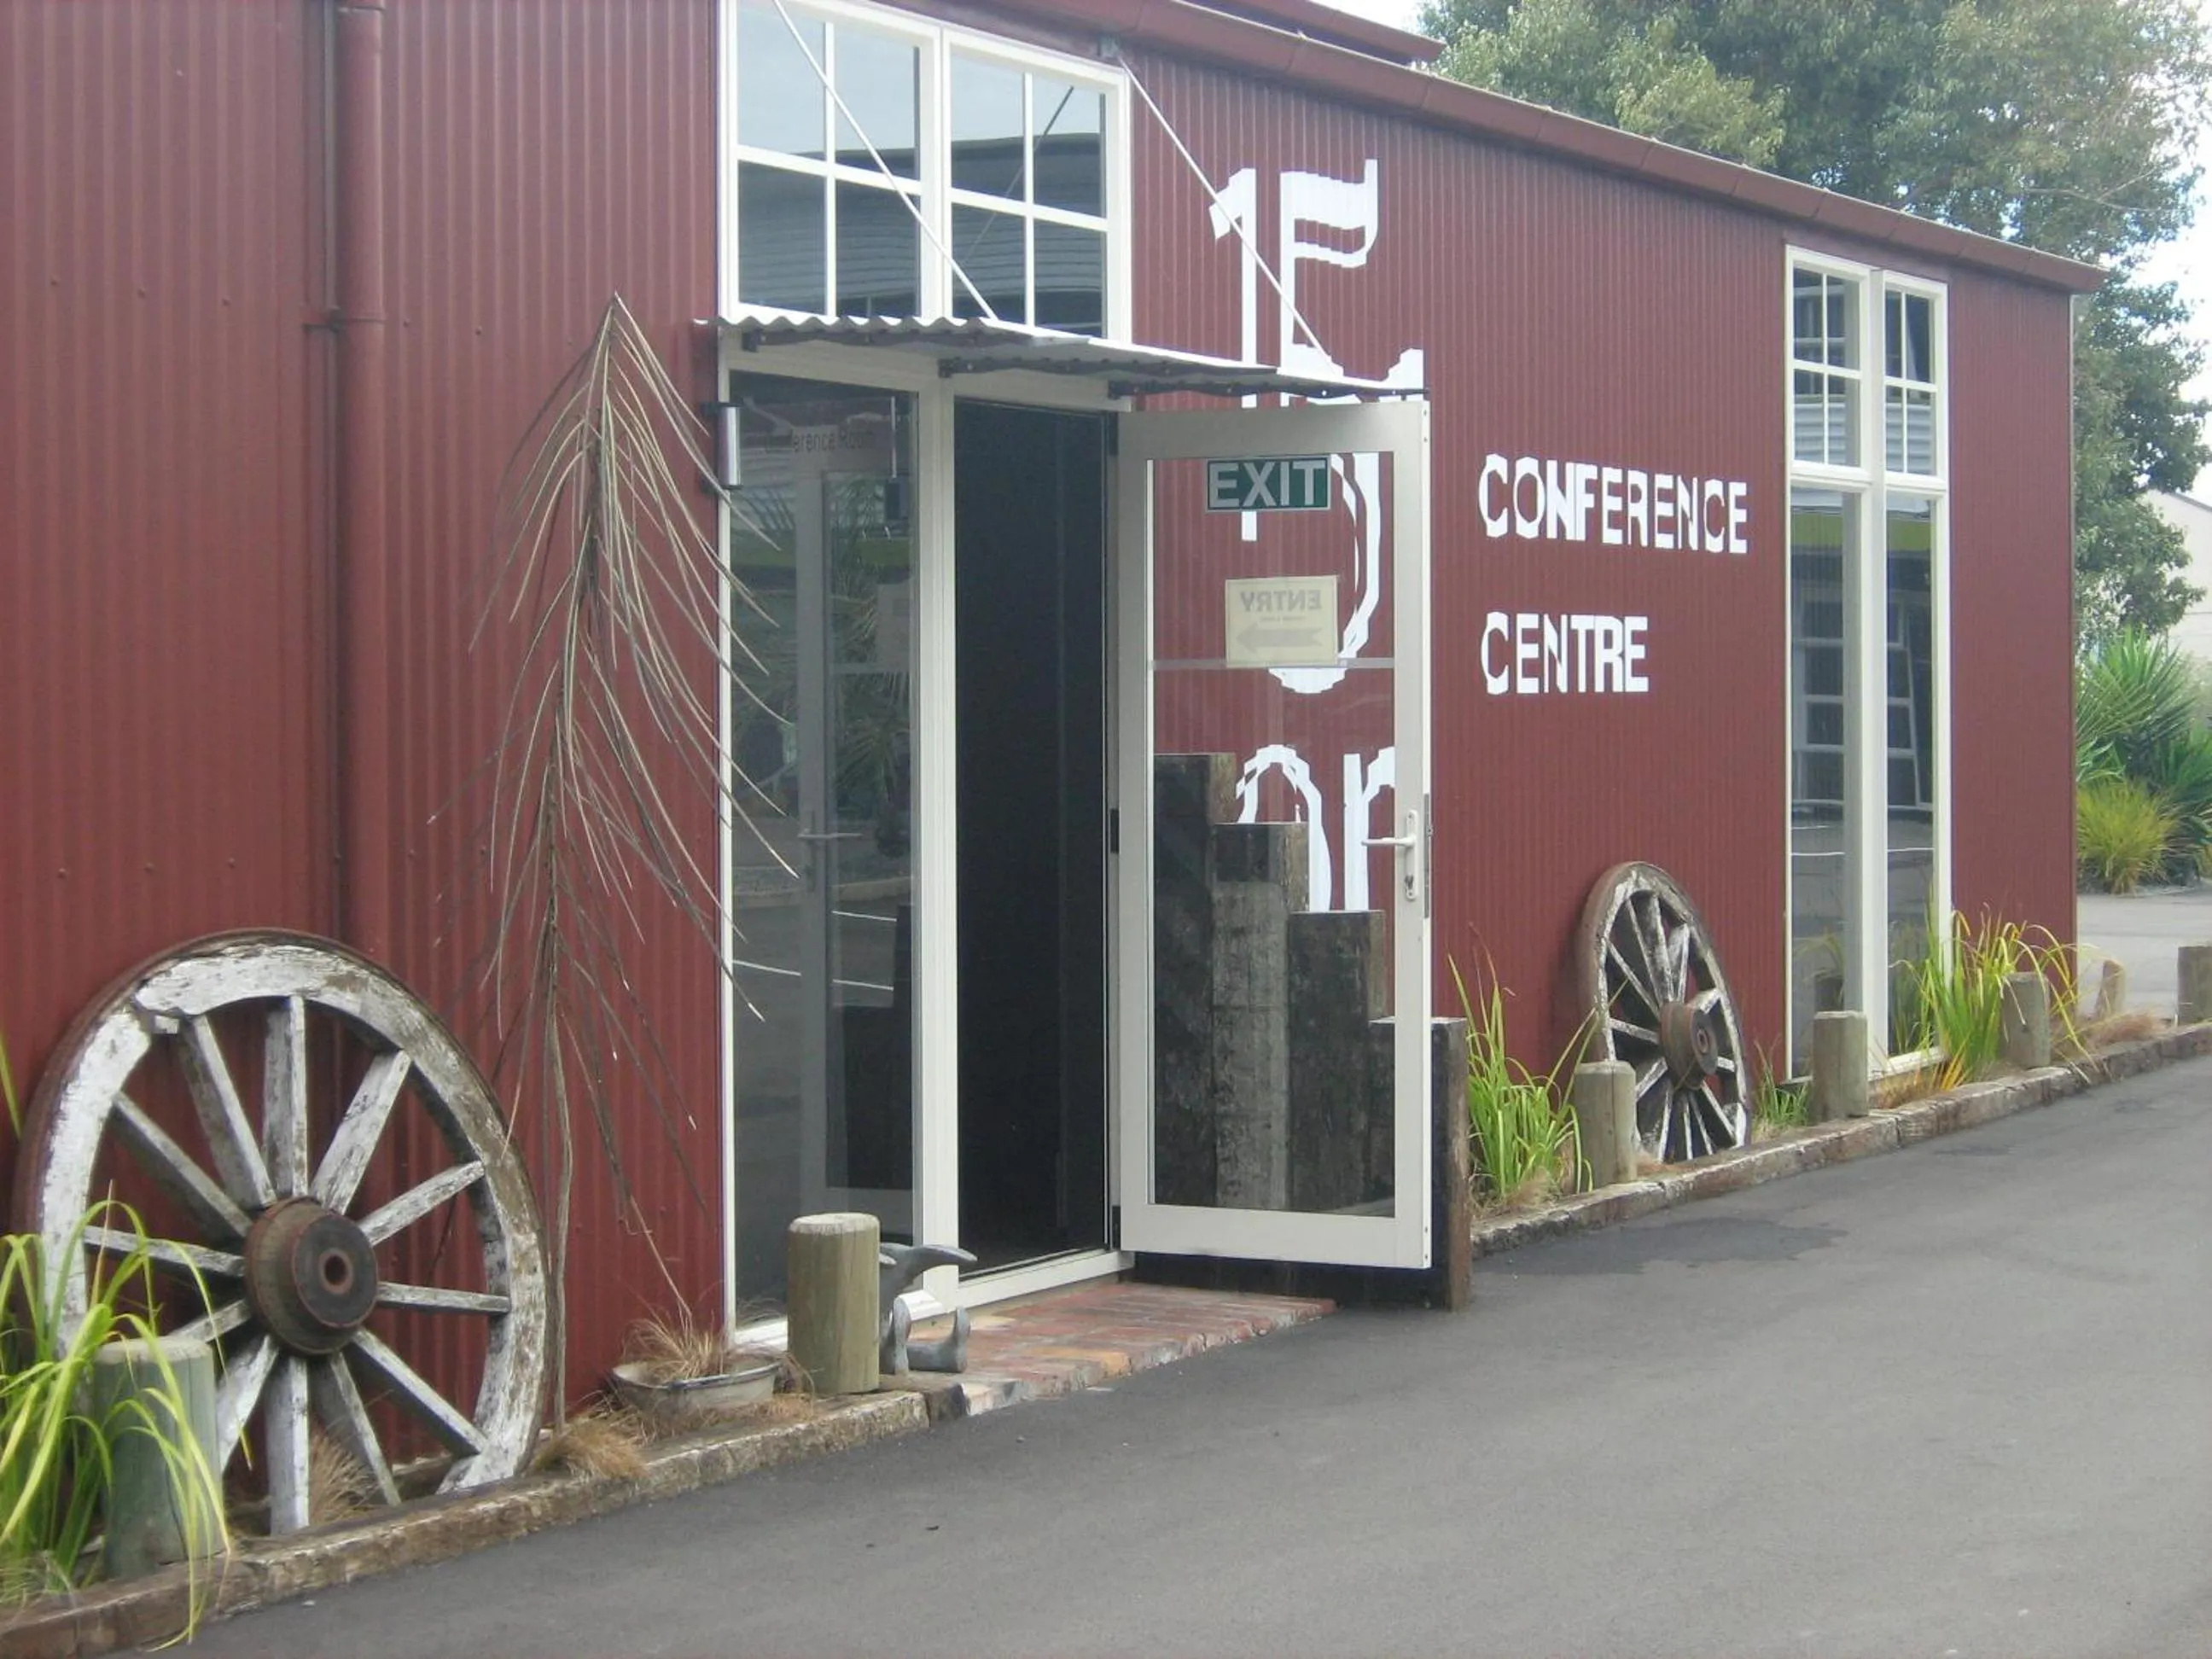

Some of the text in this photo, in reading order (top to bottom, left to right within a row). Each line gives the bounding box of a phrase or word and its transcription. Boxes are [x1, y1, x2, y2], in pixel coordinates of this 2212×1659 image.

[1208, 461, 1326, 508] EXIT
[1478, 453, 1748, 554] CONFERENCE
[1480, 611, 1650, 696] CENTRE
